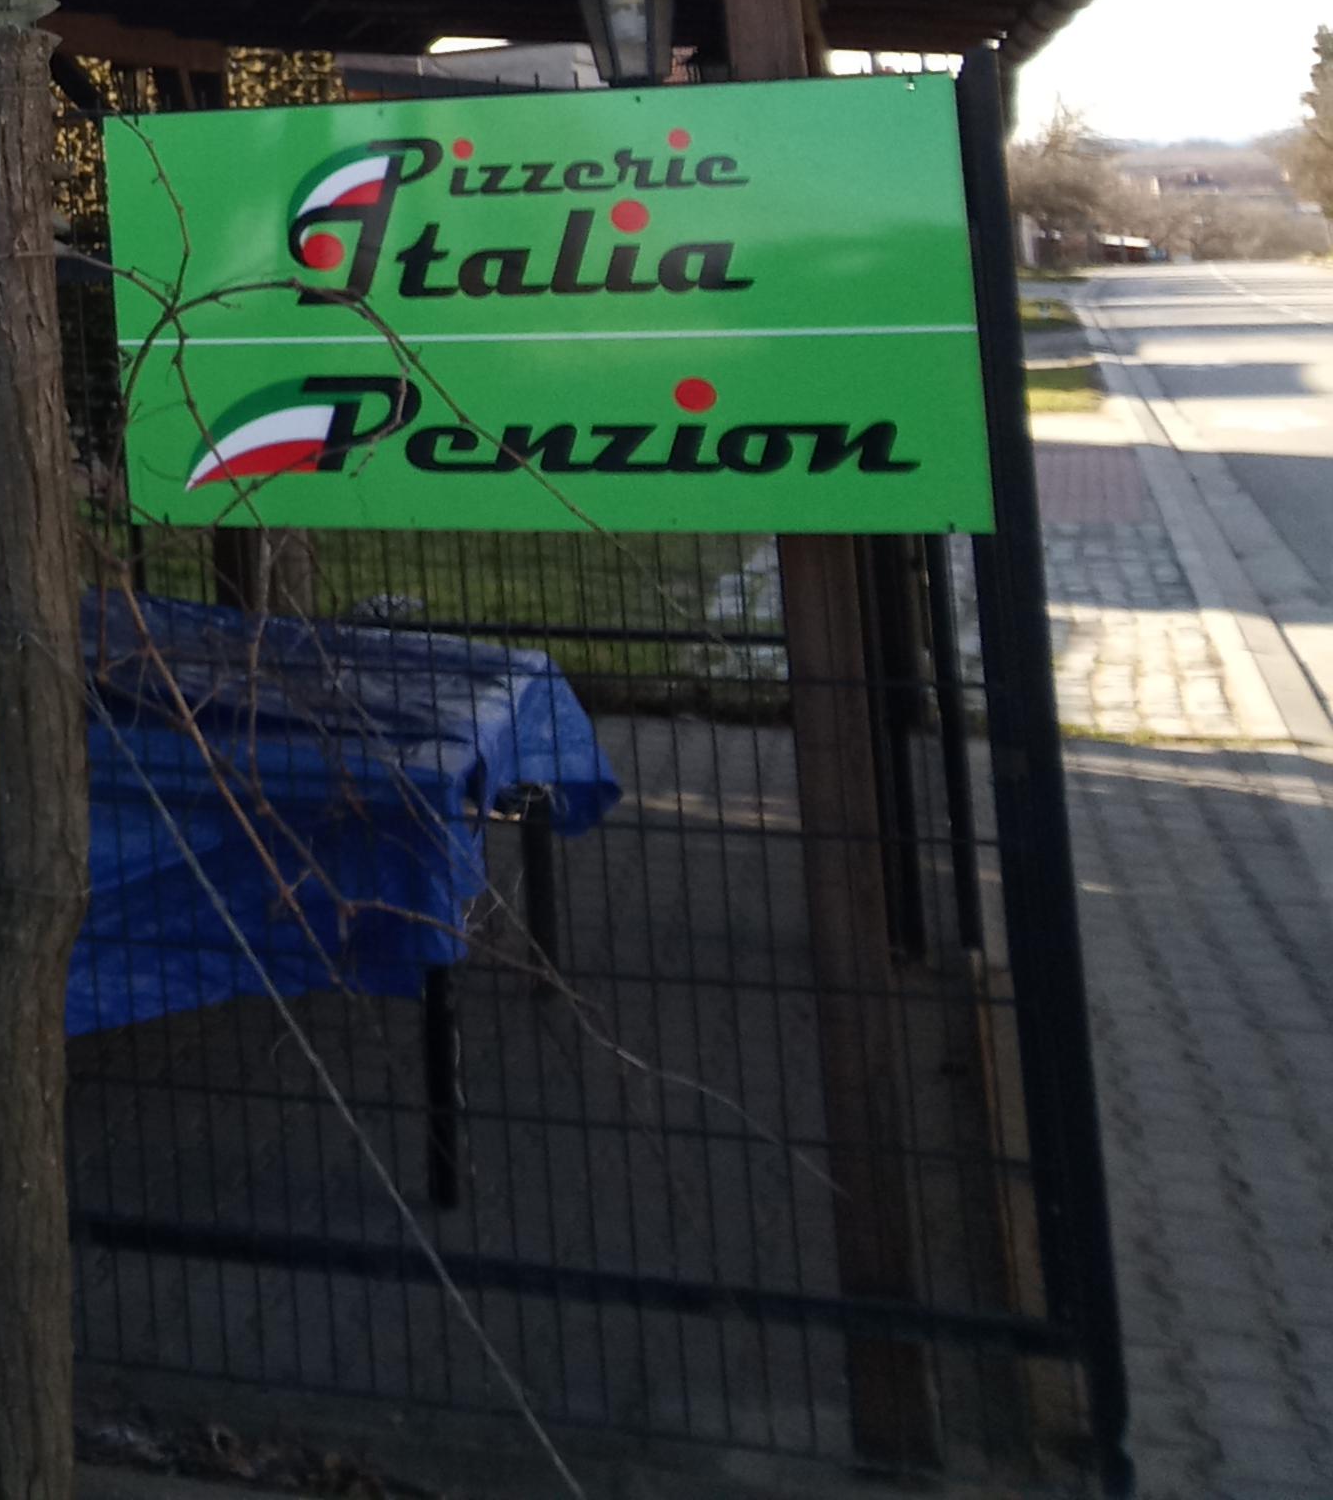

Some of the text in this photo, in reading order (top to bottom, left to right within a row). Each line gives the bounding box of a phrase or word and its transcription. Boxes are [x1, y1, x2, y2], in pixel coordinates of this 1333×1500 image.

[363, 128, 750, 198] Pizzerie
[288, 199, 755, 306] Italia
[300, 375, 921, 475] Penzion
